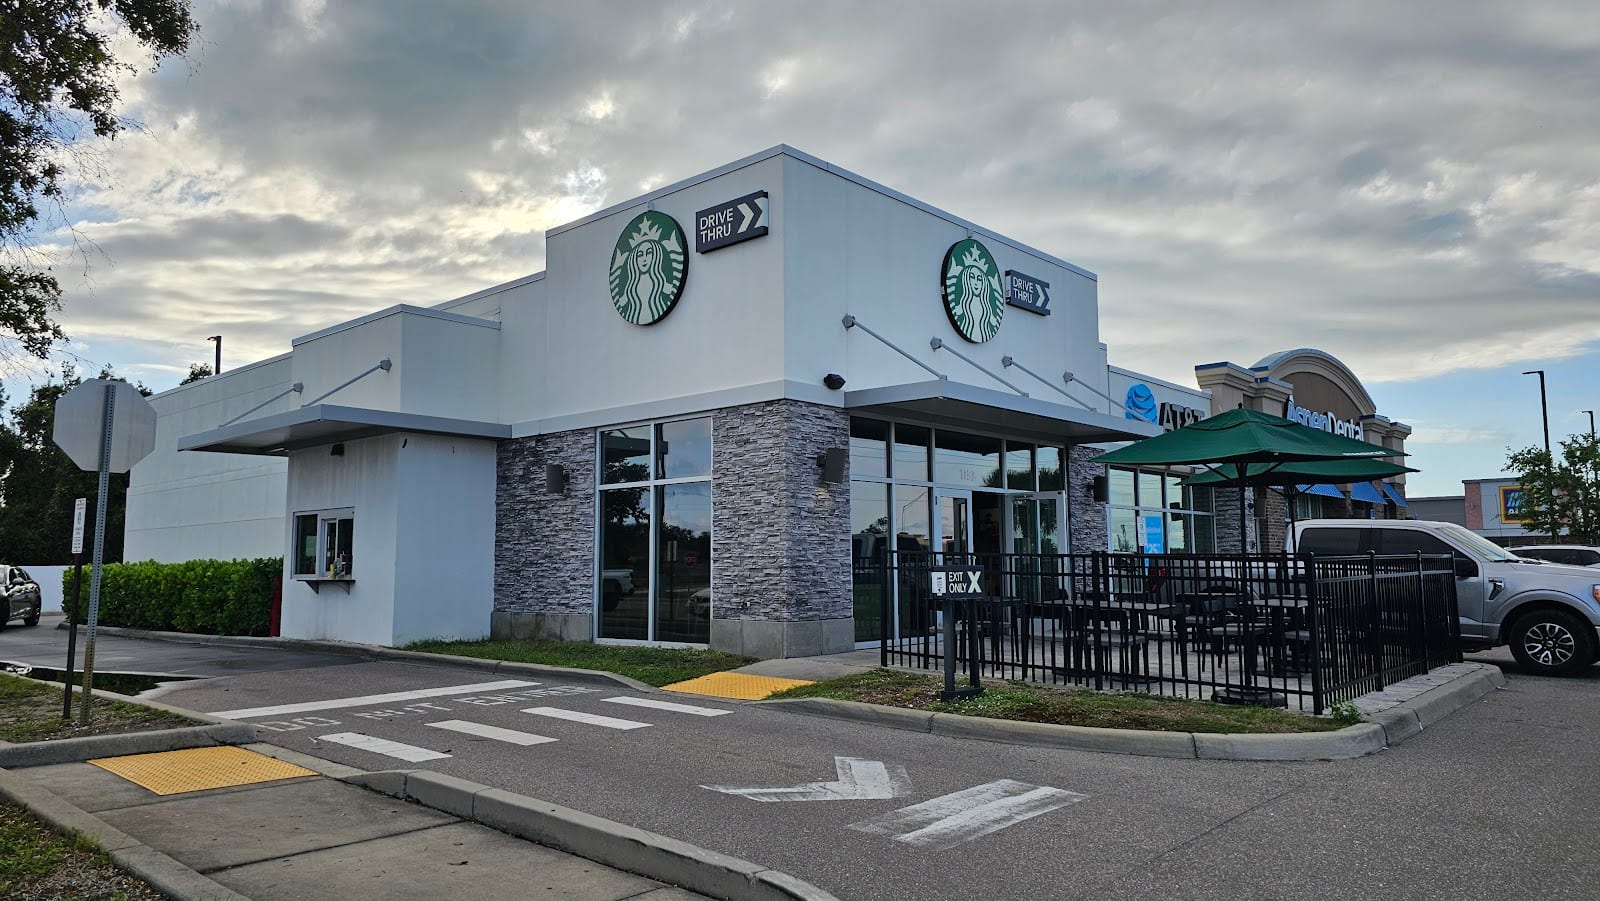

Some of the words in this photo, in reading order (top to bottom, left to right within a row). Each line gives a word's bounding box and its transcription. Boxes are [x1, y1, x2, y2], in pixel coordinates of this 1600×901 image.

[700, 208, 733, 230] DRIVE
[701, 223, 731, 243] THRU
[1013, 277, 1034, 293] DRIVE
[1013, 287, 1033, 304] THRU
[949, 571, 963, 581] EXIT
[949, 583, 967, 593] ONLY
[250, 717, 342, 731] DO
